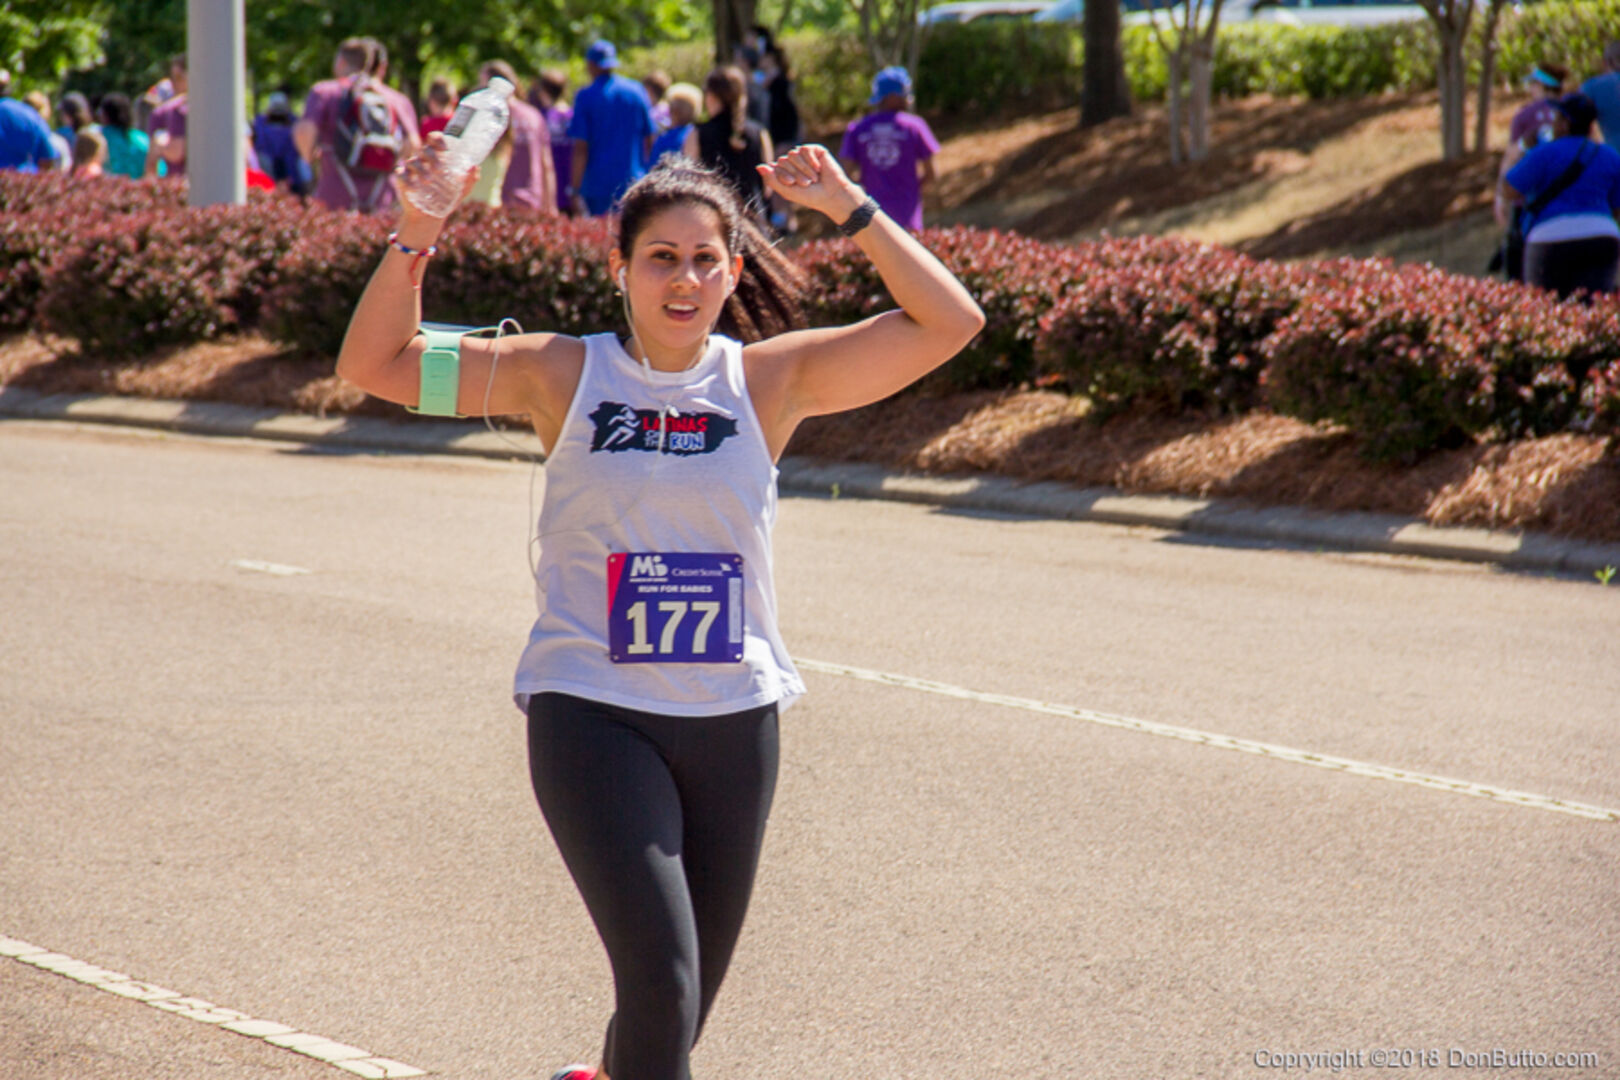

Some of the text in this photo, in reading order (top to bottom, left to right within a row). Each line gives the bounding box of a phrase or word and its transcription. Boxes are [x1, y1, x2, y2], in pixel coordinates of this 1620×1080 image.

[669, 431, 705, 451] RUN
[660, 585, 678, 593] FOR
[626, 601, 721, 654] 177
